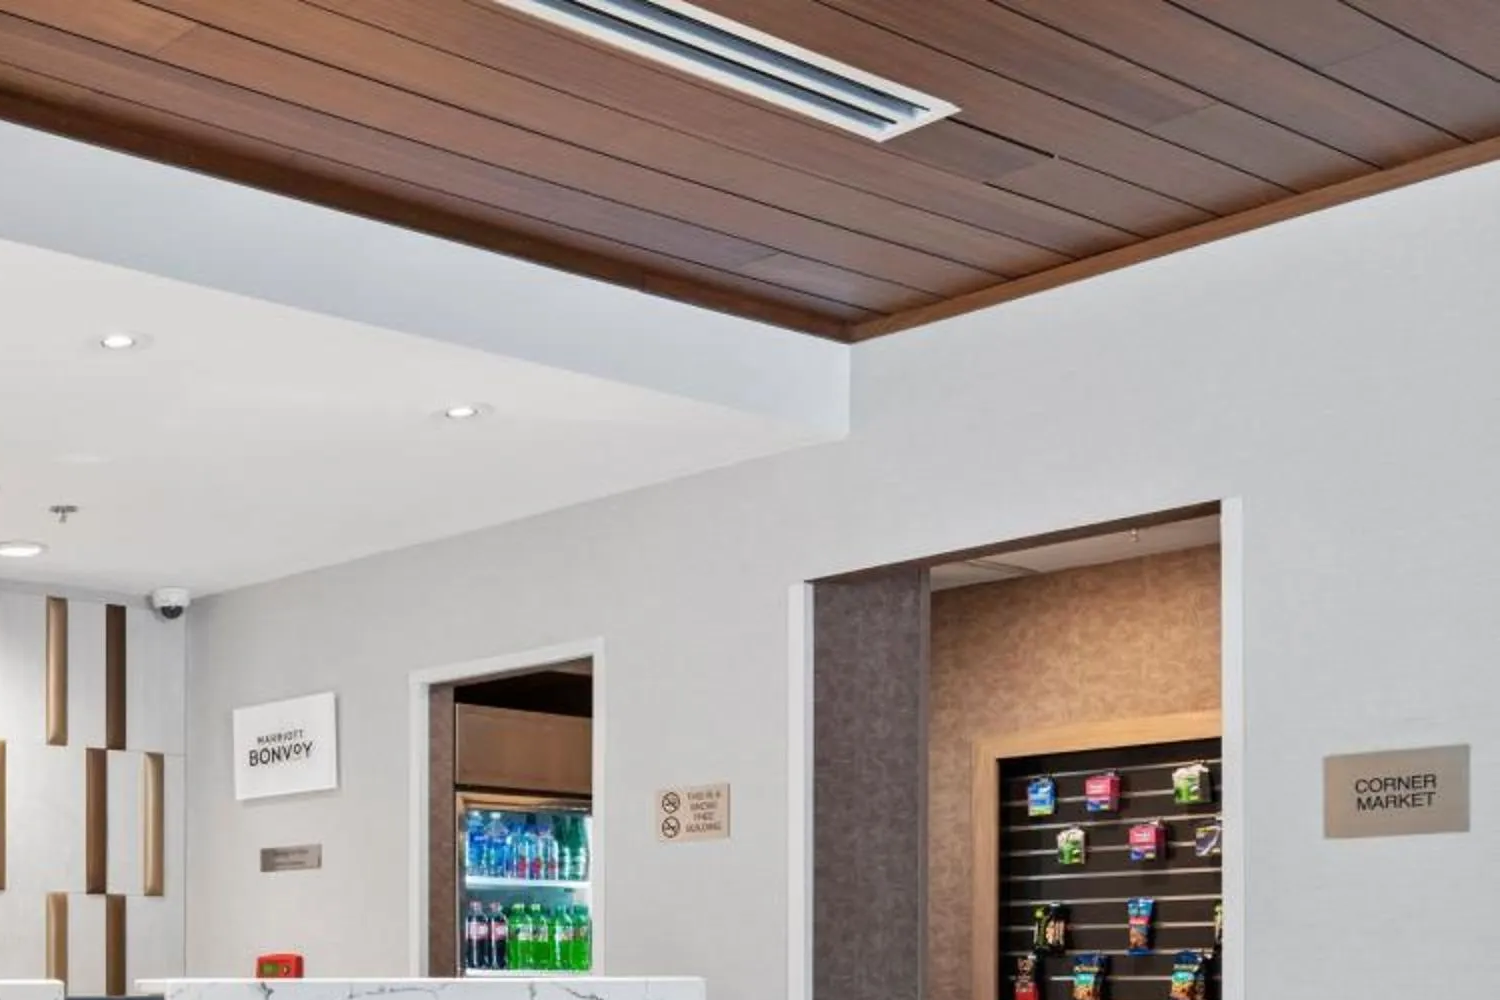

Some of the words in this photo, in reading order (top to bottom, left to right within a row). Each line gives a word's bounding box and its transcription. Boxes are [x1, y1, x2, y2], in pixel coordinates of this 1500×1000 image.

[249, 741, 313, 767] BONVOY
[1354, 773, 1437, 794] CORNER
[1356, 791, 1436, 812] MARKET
